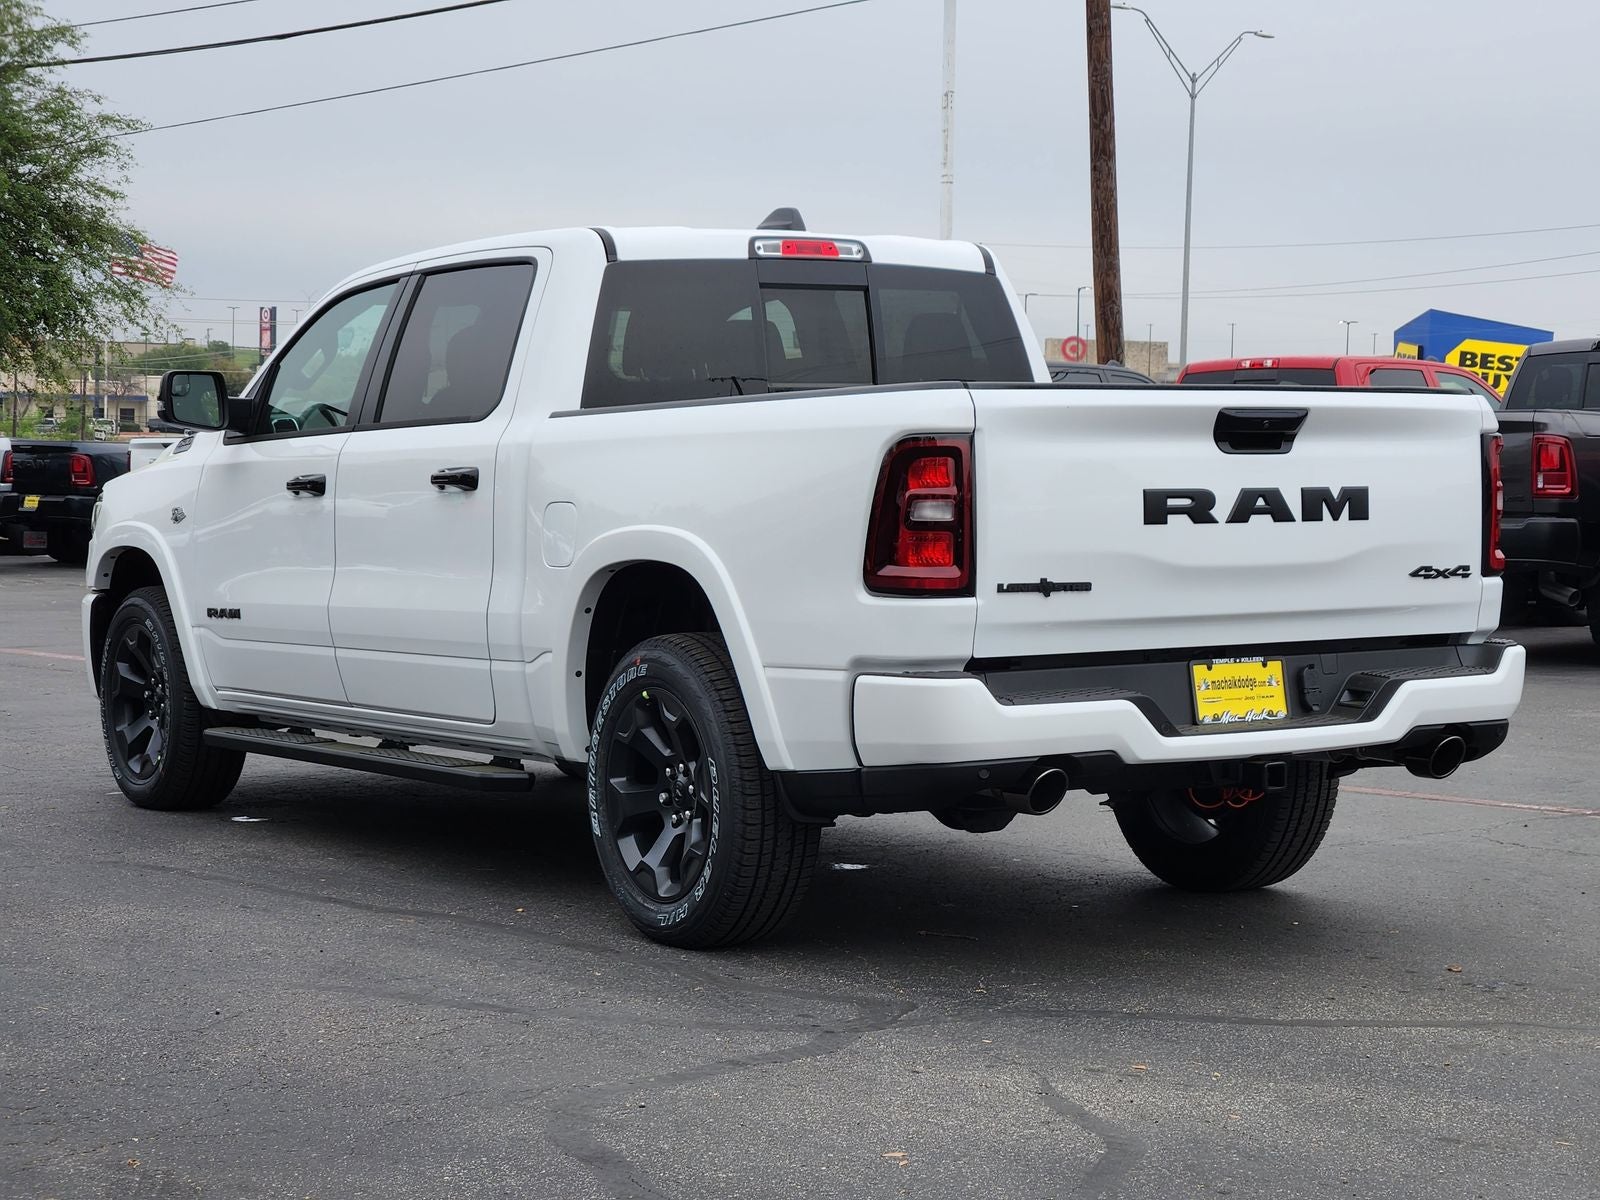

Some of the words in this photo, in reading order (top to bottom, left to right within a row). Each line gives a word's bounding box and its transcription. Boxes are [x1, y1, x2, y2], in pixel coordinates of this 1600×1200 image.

[1459, 351, 1520, 372] BES
[1143, 486, 1369, 525] RAM
[1408, 565, 1472, 579] 4x4
[207, 608, 241, 619] RAM
[1211, 675, 1267, 691] machaikdodge.com
[587, 663, 648, 838] BRIDGESTONE
[694, 757, 721, 902] DUELER
[657, 902, 689, 926] H/L
